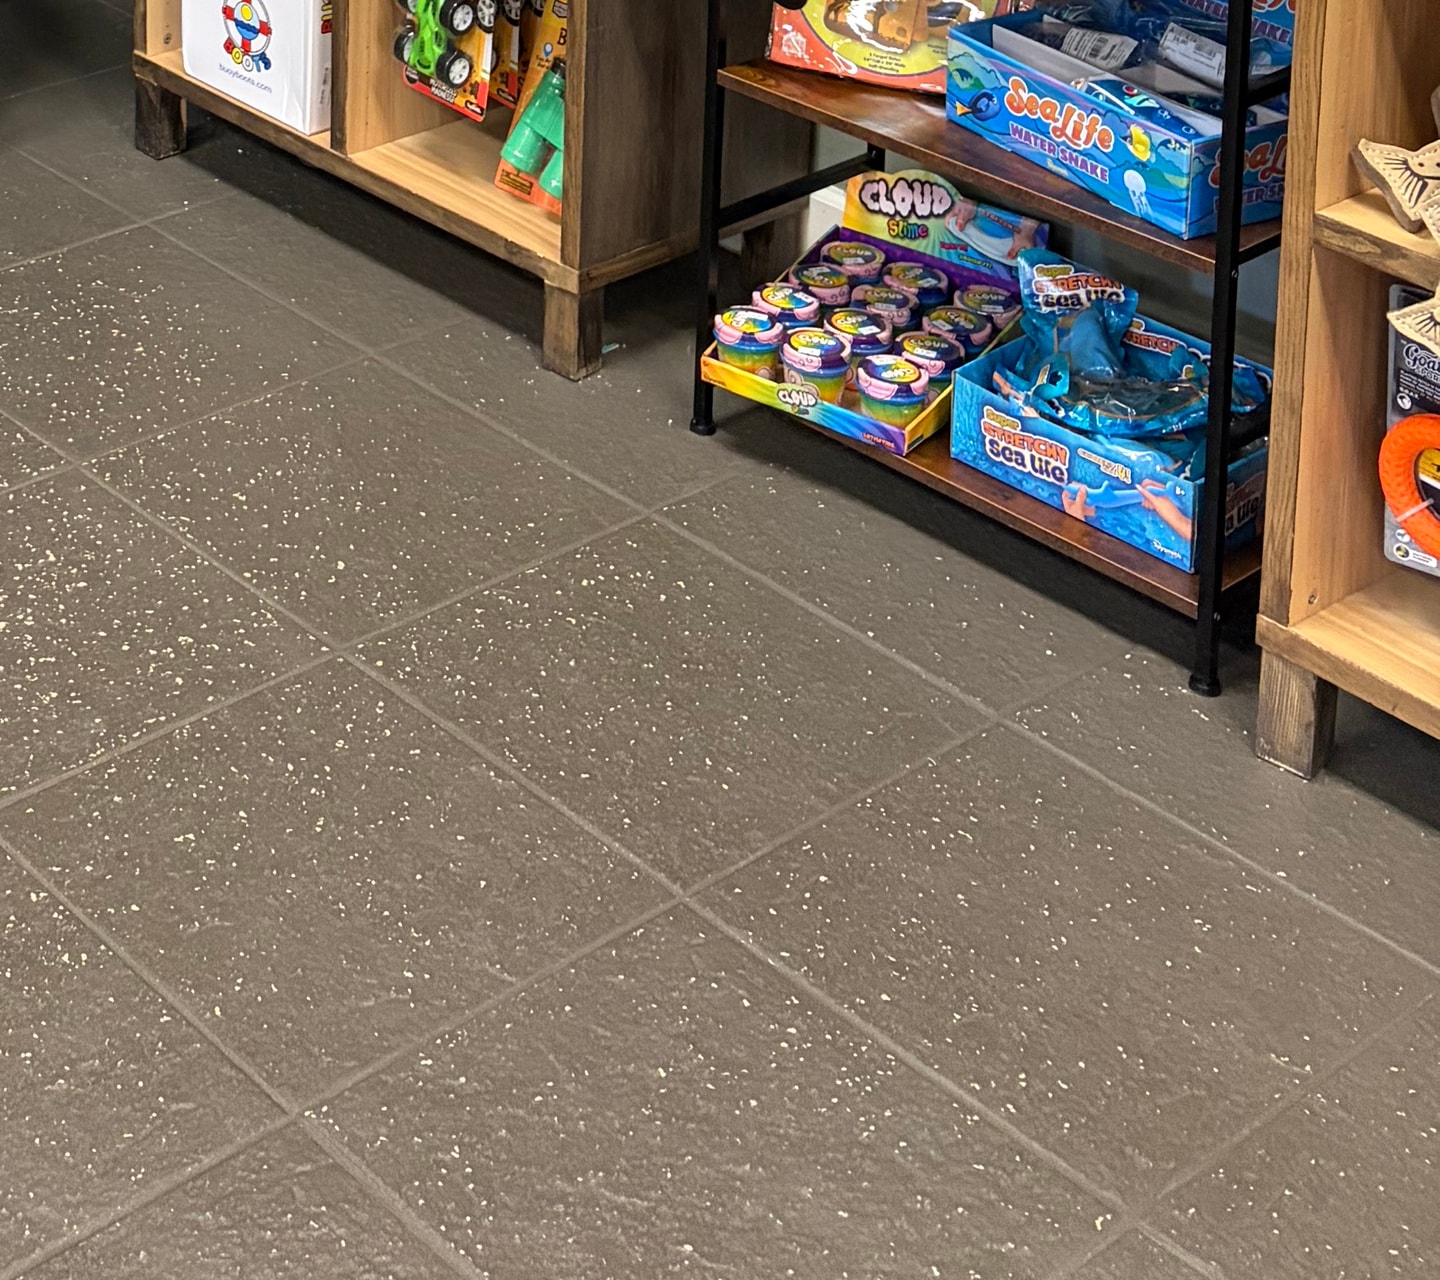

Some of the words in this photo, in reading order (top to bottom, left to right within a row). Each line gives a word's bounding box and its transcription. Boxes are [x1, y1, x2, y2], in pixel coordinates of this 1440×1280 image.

[222, 36, 272, 73] BOOTS
[218, 62, 273, 94] buoyboots.com
[1003, 76, 1059, 130] Sea
[1049, 99, 1115, 153] Life
[1009, 120, 1057, 158] WATER
[1059, 147, 1109, 185] SNAKE
[859, 177, 953, 218] CLOUD
[886, 218, 929, 240] Slime
[1033, 275, 1124, 294] STRETCHY
[1034, 265, 1074, 278] Super
[798, 333, 837, 347] CLOUD
[777, 388, 818, 407] CLOUD
[983, 407, 1021, 430] Super
[981, 422, 1069, 466] STRETCHY
[986, 439, 1027, 470] Sea
[1028, 448, 1069, 485] Life
